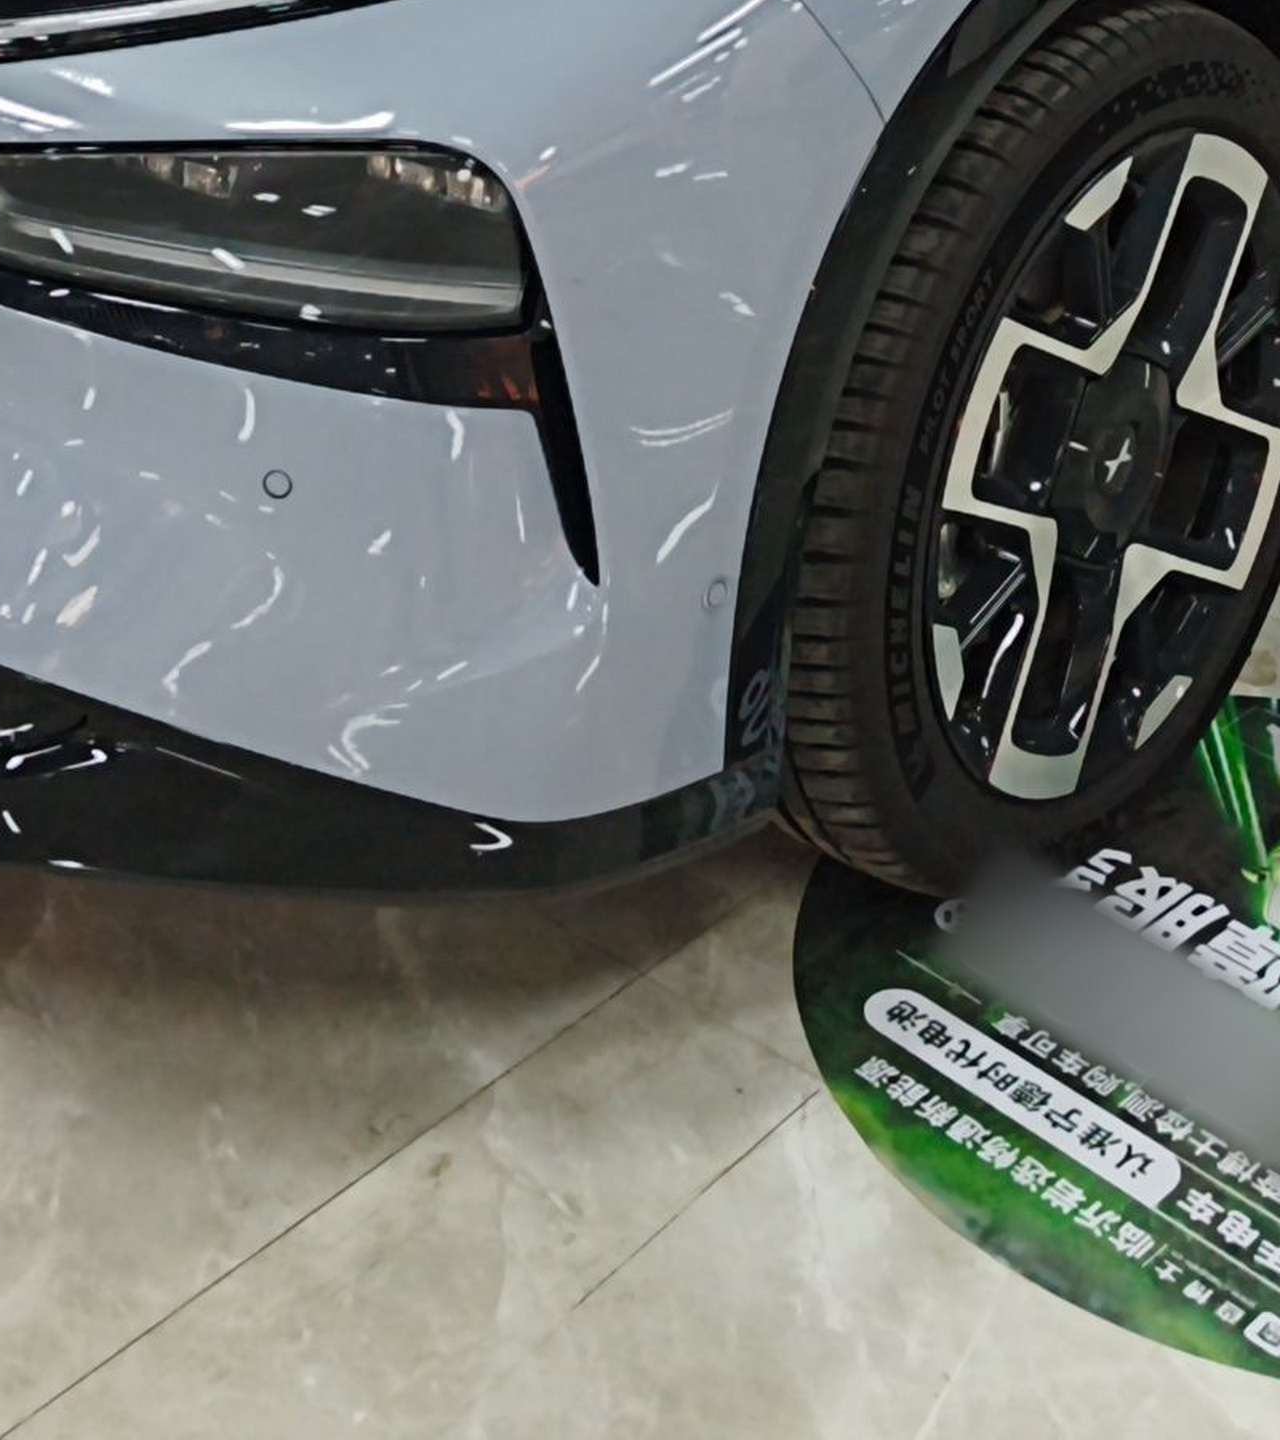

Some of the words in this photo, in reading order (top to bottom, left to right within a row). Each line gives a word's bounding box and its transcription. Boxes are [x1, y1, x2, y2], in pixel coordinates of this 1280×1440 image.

[889, 484, 923, 737] MICHELIN
[919, 368, 953, 456] PILOT
[950, 269, 995, 365] SPORT
[886, 1000, 1151, 1176] 认准宁德时代电池
